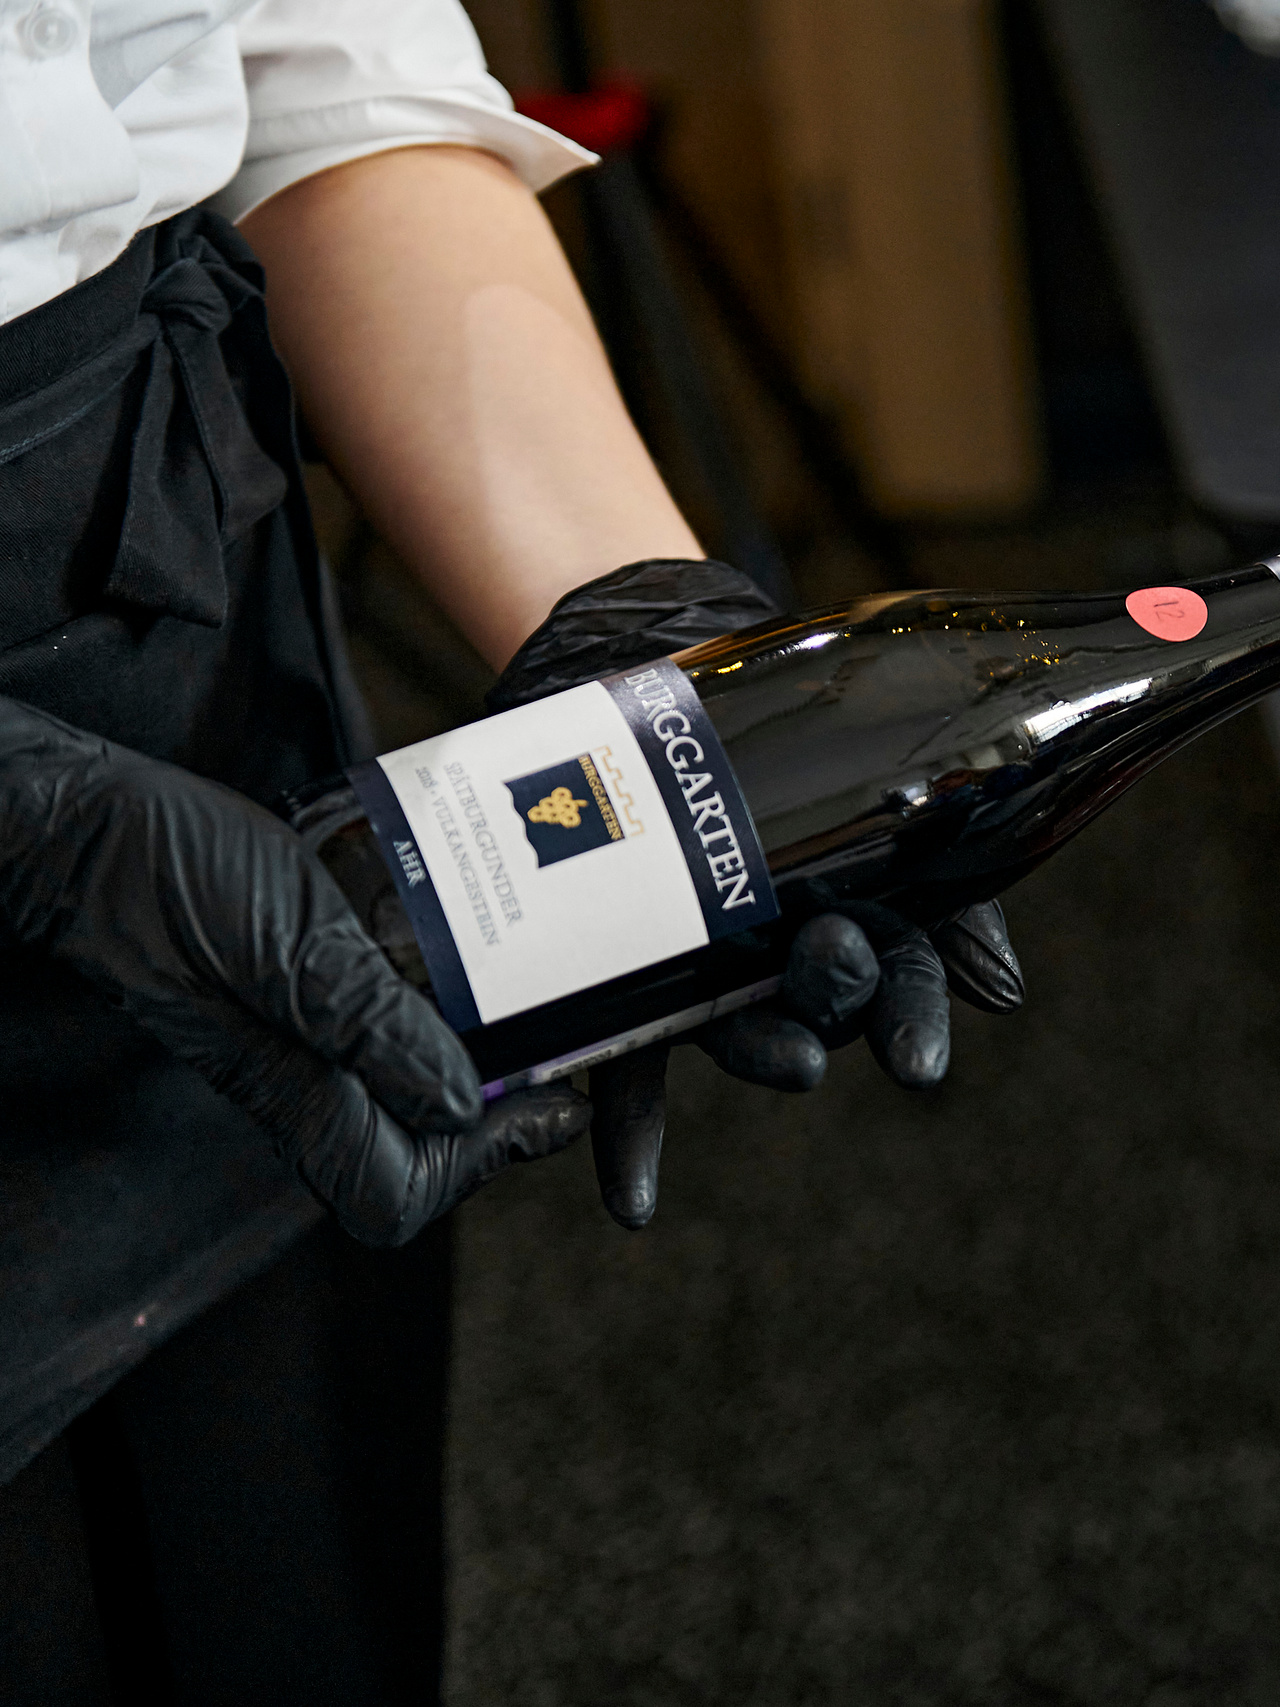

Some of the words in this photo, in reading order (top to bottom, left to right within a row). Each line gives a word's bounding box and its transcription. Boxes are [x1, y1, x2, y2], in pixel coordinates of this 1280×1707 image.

[393, 840, 426, 889] AHR
[415, 766, 438, 789] 2018
[432, 795, 499, 946] VULKANGESTEIN
[443, 761, 523, 928] SPÄTBURGUNDER
[578, 755, 624, 841] BURGGARTEN
[624, 668, 756, 911] BURGGARTEN
